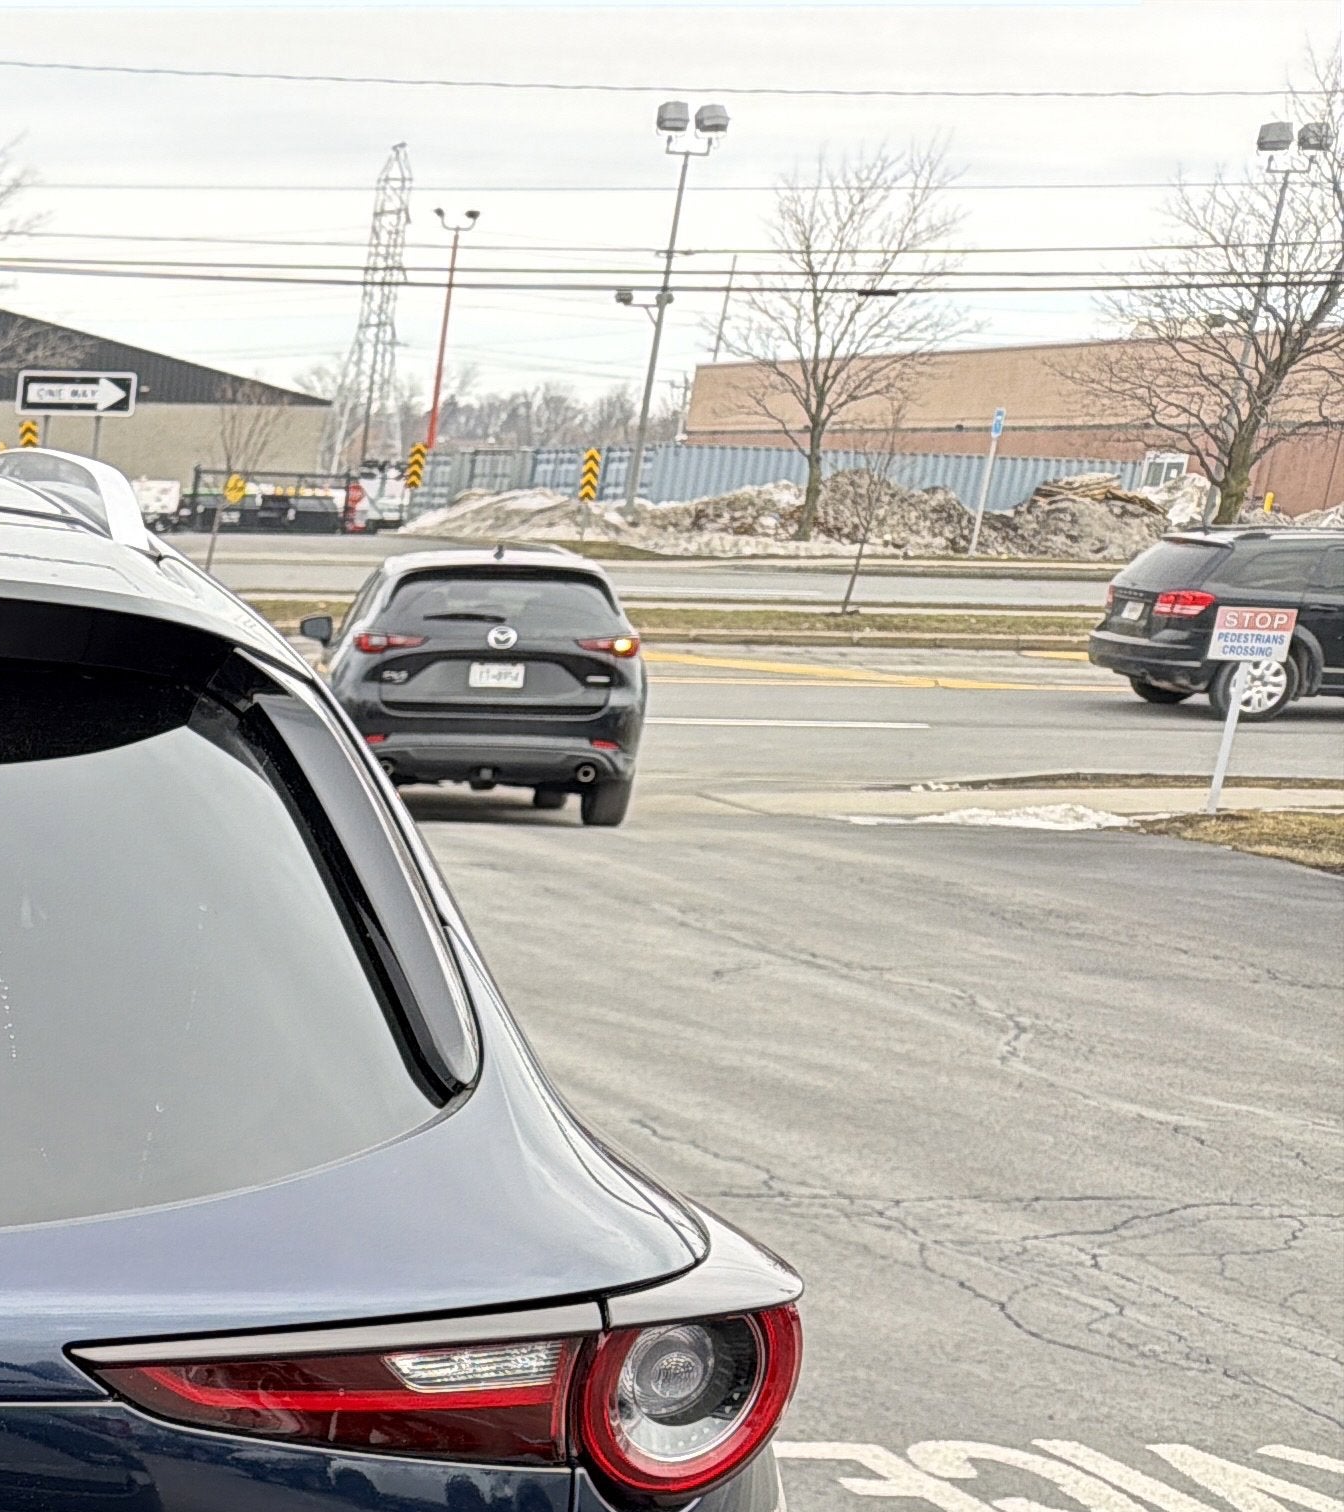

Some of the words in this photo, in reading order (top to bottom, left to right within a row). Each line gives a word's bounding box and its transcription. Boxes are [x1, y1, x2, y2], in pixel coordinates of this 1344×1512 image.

[1224, 610, 1289, 630] STOP
[1217, 632, 1285, 646] PEDESTRIANS
[1222, 645, 1273, 658] CROSSING
